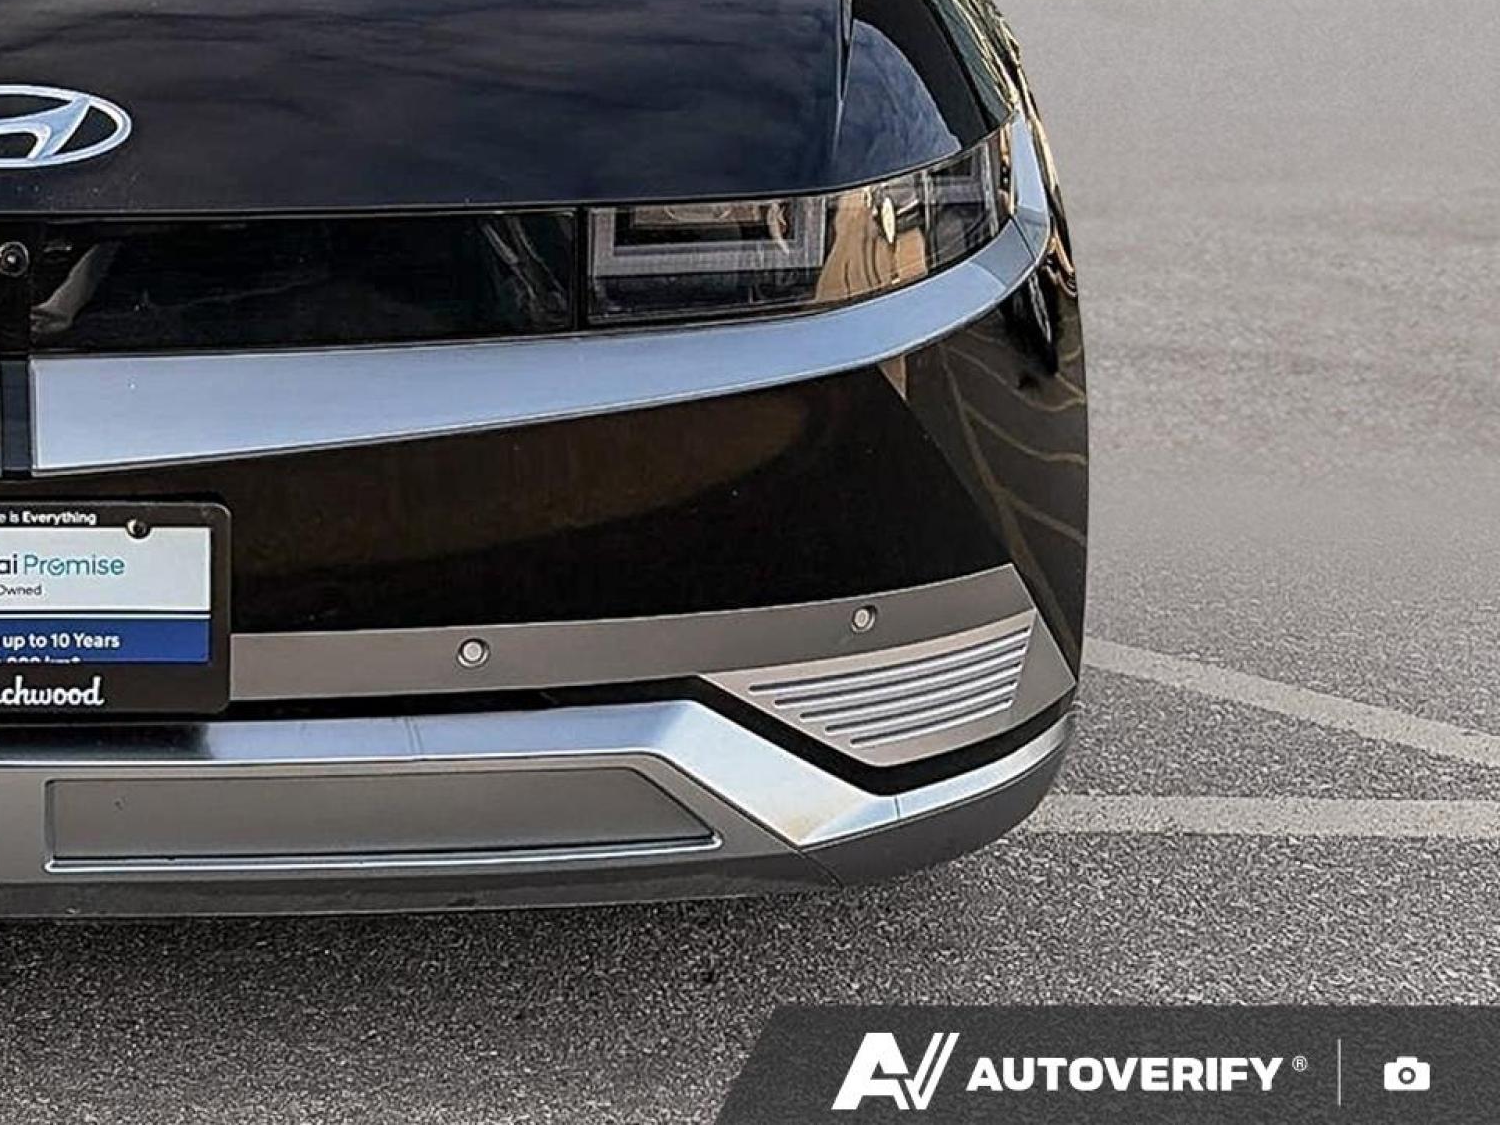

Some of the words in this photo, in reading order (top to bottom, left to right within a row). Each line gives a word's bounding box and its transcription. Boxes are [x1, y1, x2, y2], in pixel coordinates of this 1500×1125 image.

[9, 512, 19, 523] is
[22, 511, 97, 525] Everything
[24, 554, 125, 575] Promise
[2, 635, 25, 651] up
[29, 634, 47, 648] to
[51, 633, 70, 648] 10
[72, 632, 120, 648] Years
